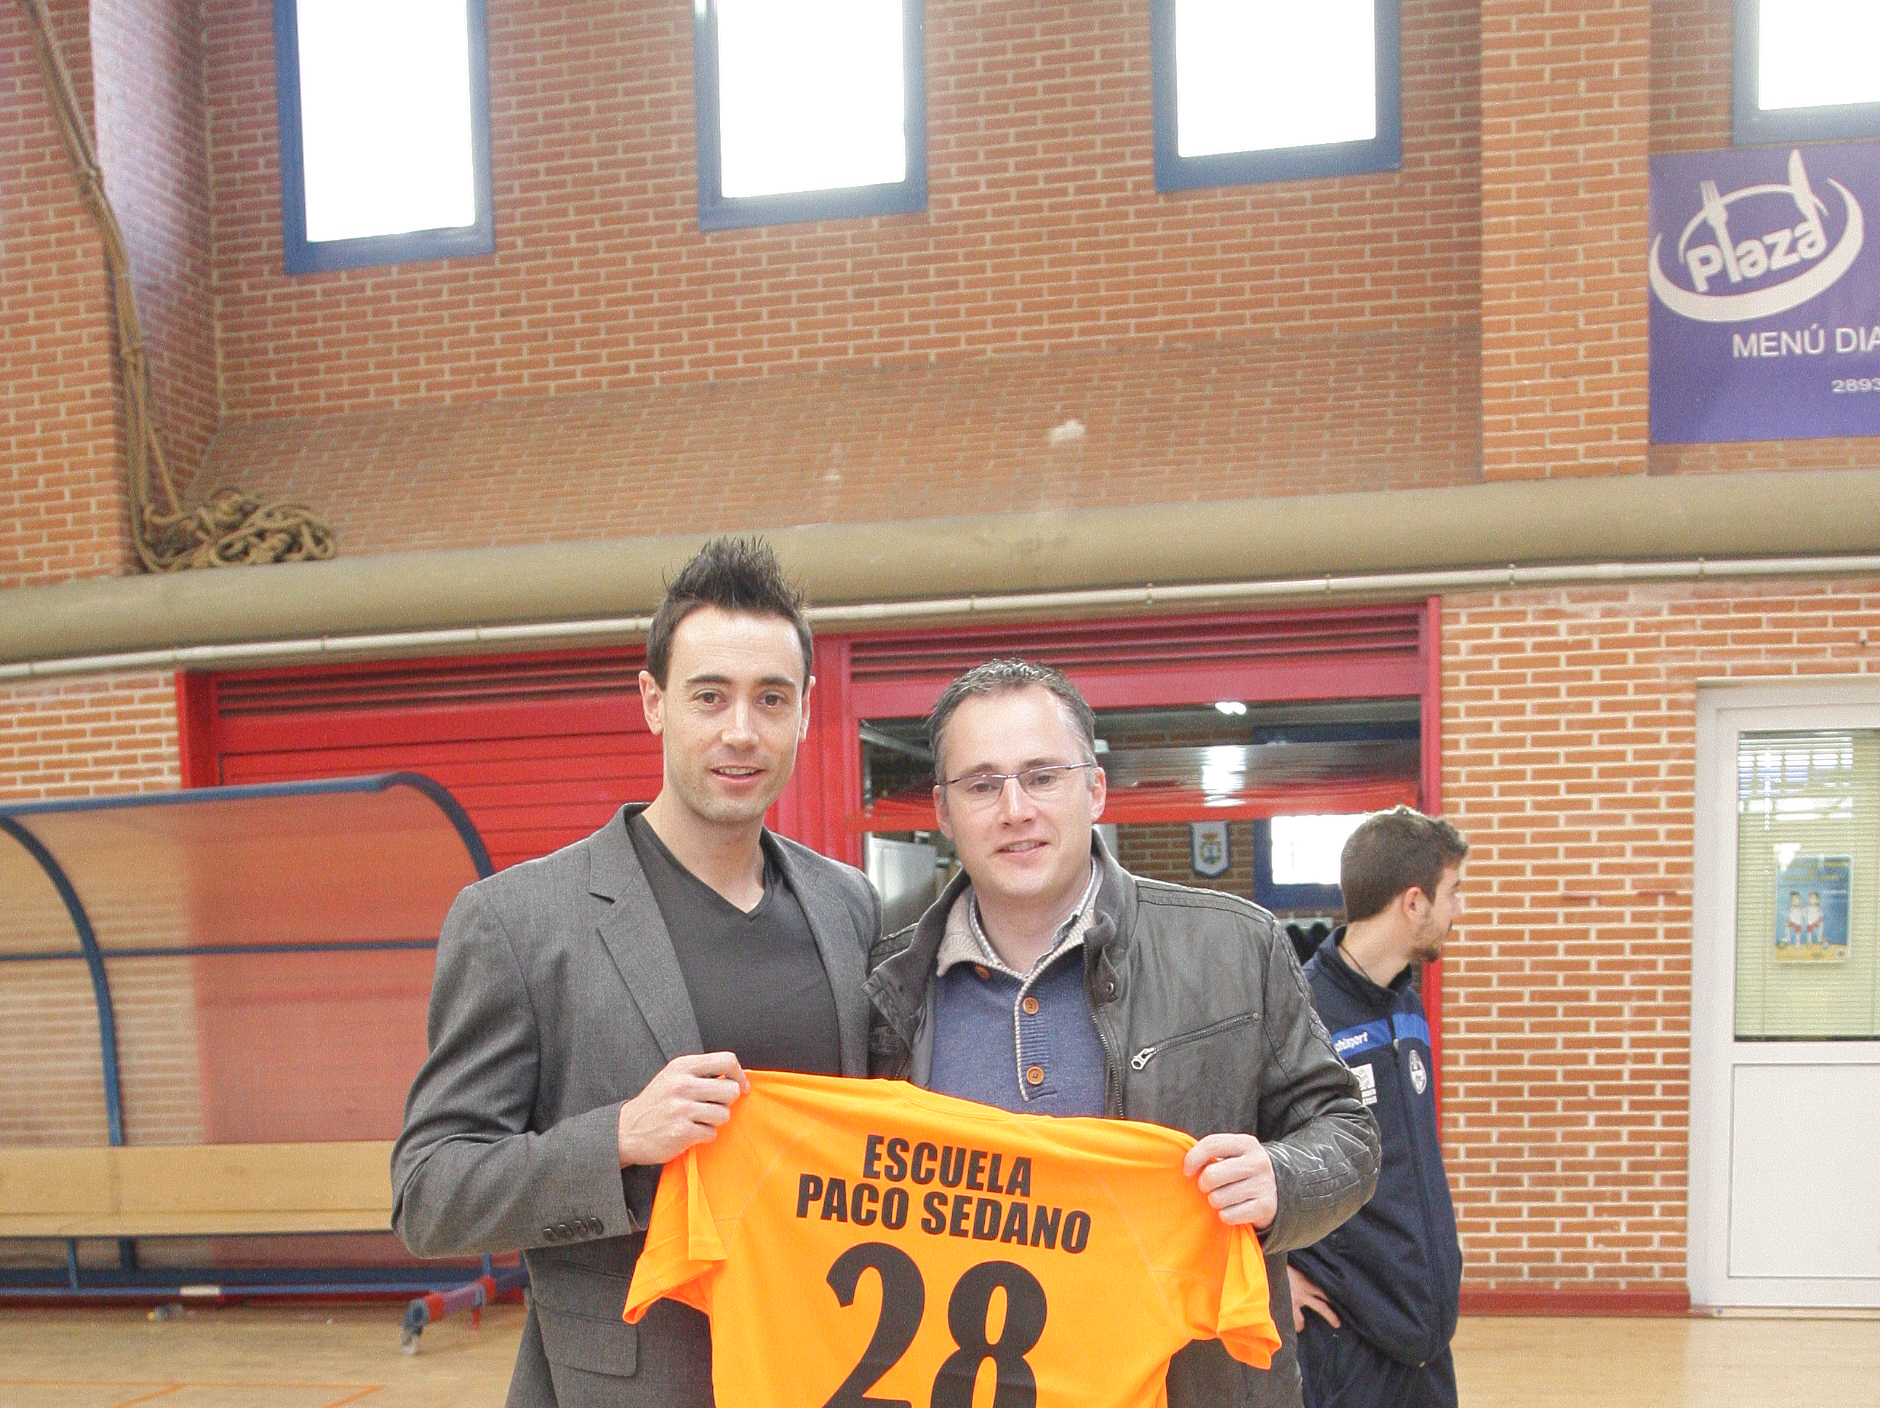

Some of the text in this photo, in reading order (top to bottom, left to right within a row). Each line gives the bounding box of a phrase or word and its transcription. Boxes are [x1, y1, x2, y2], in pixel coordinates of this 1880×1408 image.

[1732, 324, 1825, 357] MENÚ
[862, 1134, 1032, 1197] ESCUELA
[796, 1173, 1092, 1254] PACO SEDANO
